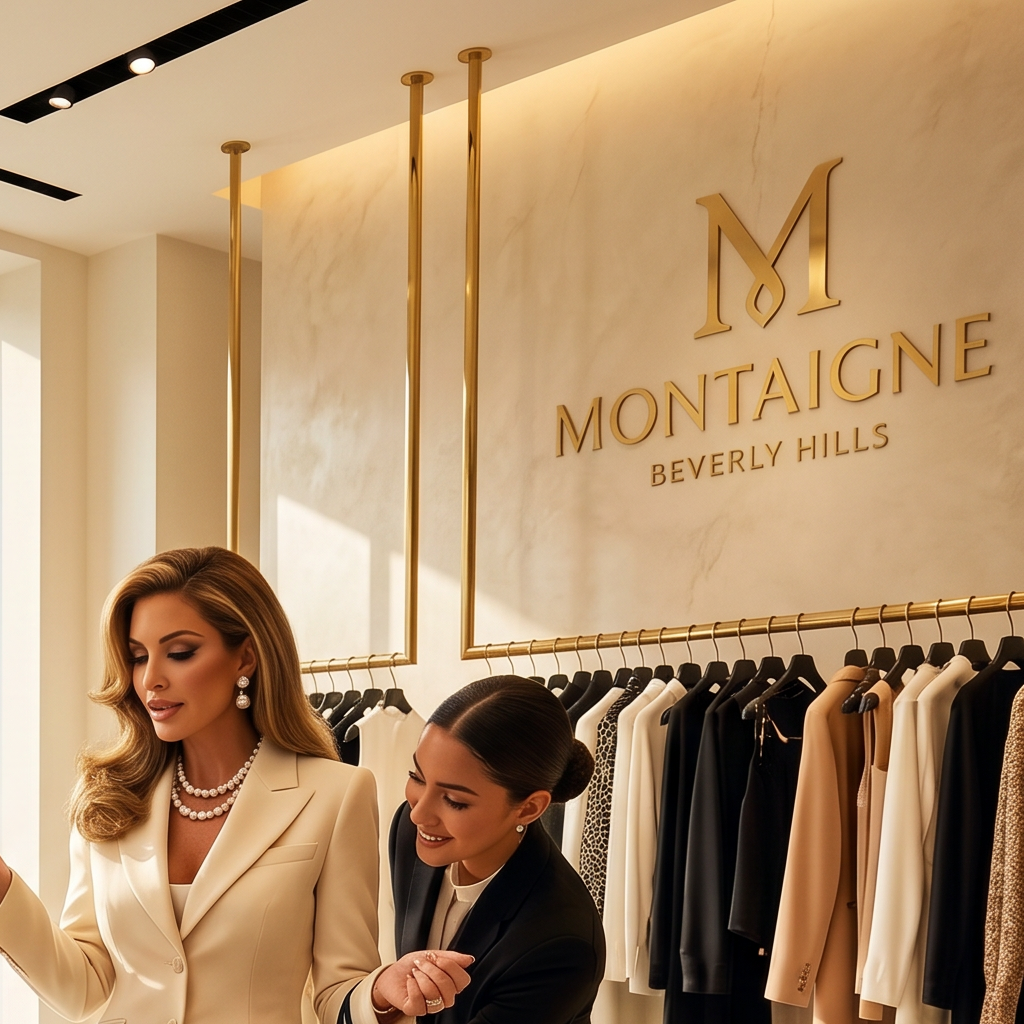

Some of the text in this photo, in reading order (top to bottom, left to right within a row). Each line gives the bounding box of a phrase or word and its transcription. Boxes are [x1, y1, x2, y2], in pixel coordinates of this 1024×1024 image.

[694, 156, 843, 340] M
[555, 312, 994, 457] MONTAIGNE
[651, 422, 890, 487] BEVERLY HILLS
